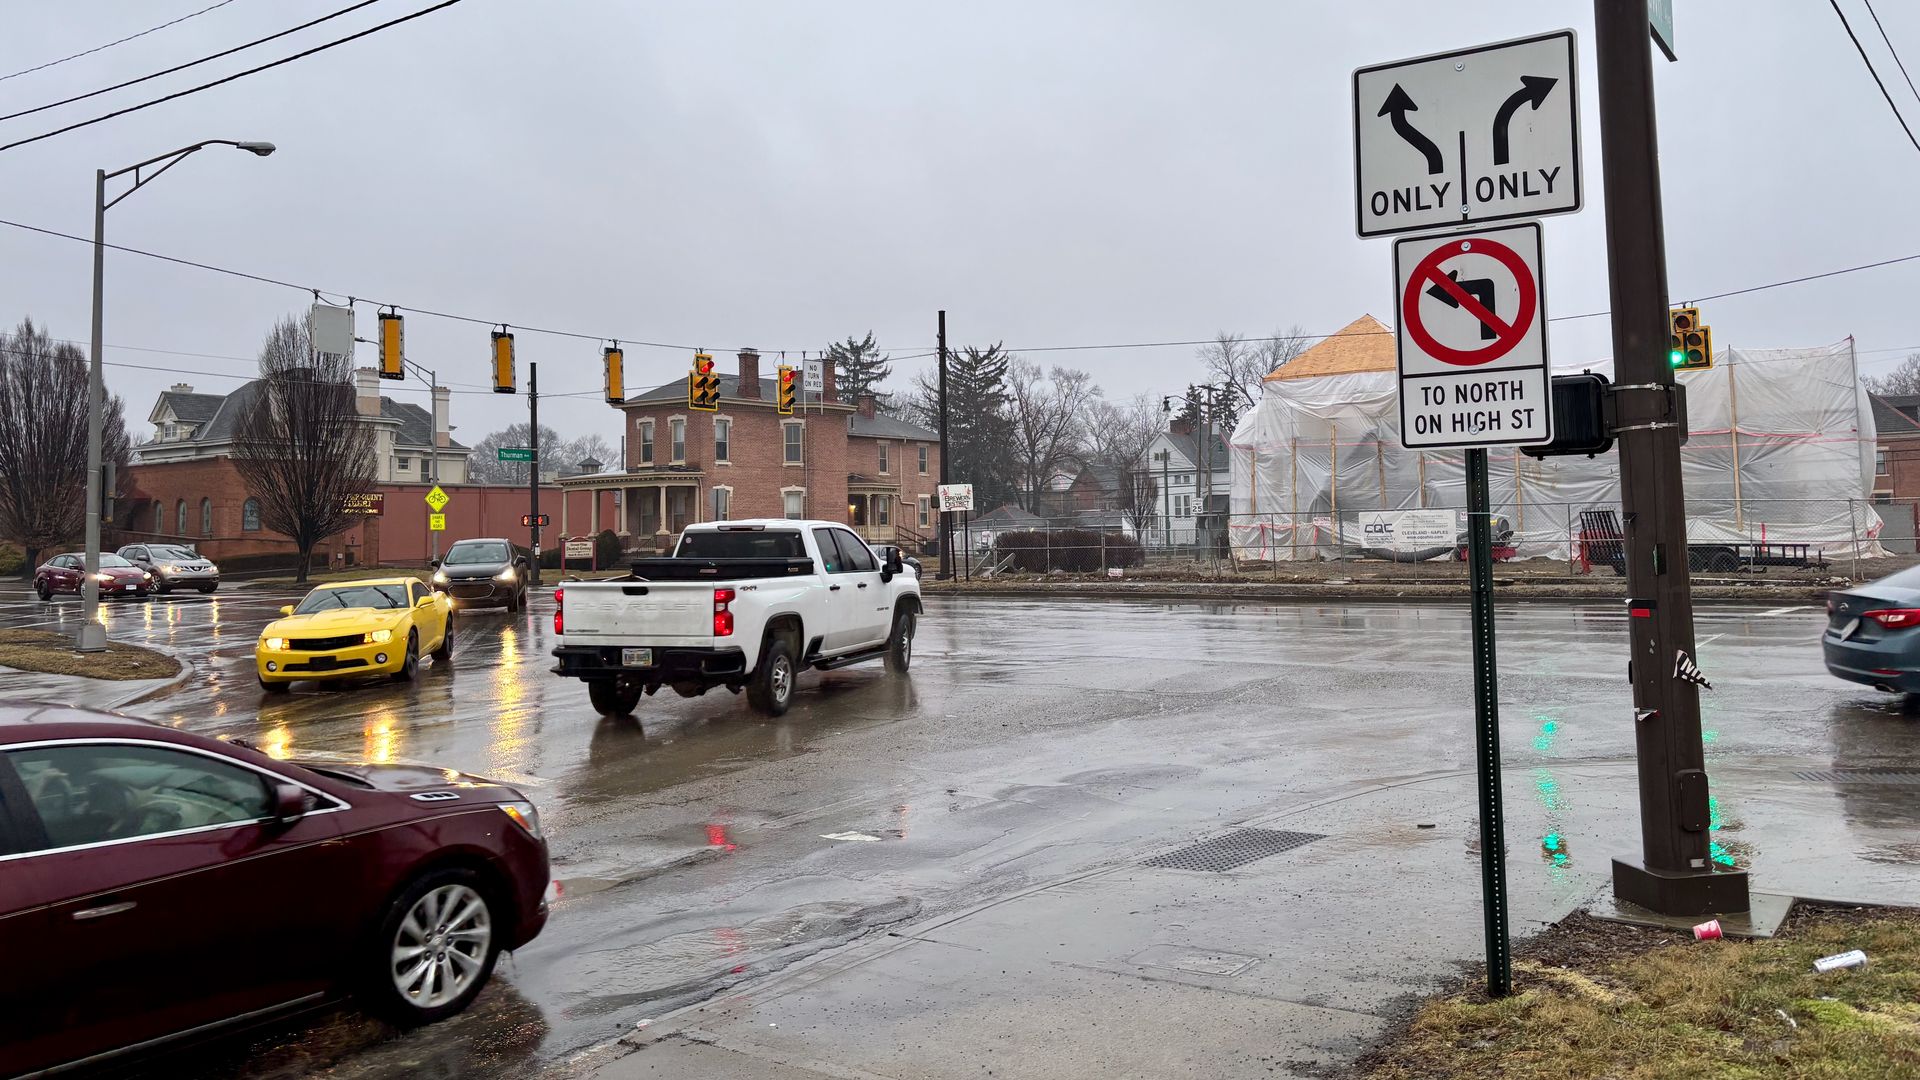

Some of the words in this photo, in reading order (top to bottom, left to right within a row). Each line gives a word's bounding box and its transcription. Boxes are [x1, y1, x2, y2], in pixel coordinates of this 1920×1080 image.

[1475, 166, 1561, 202] ONLY
[1371, 181, 1451, 216] ONLY
[1420, 385, 1446, 406] TO
[1455, 380, 1524, 404] NORTH
[1414, 414, 1442, 434] ON
[1451, 410, 1501, 433] HIGH
[1511, 408, 1535, 429] ST
[1364, 523, 1394, 533] CQC
